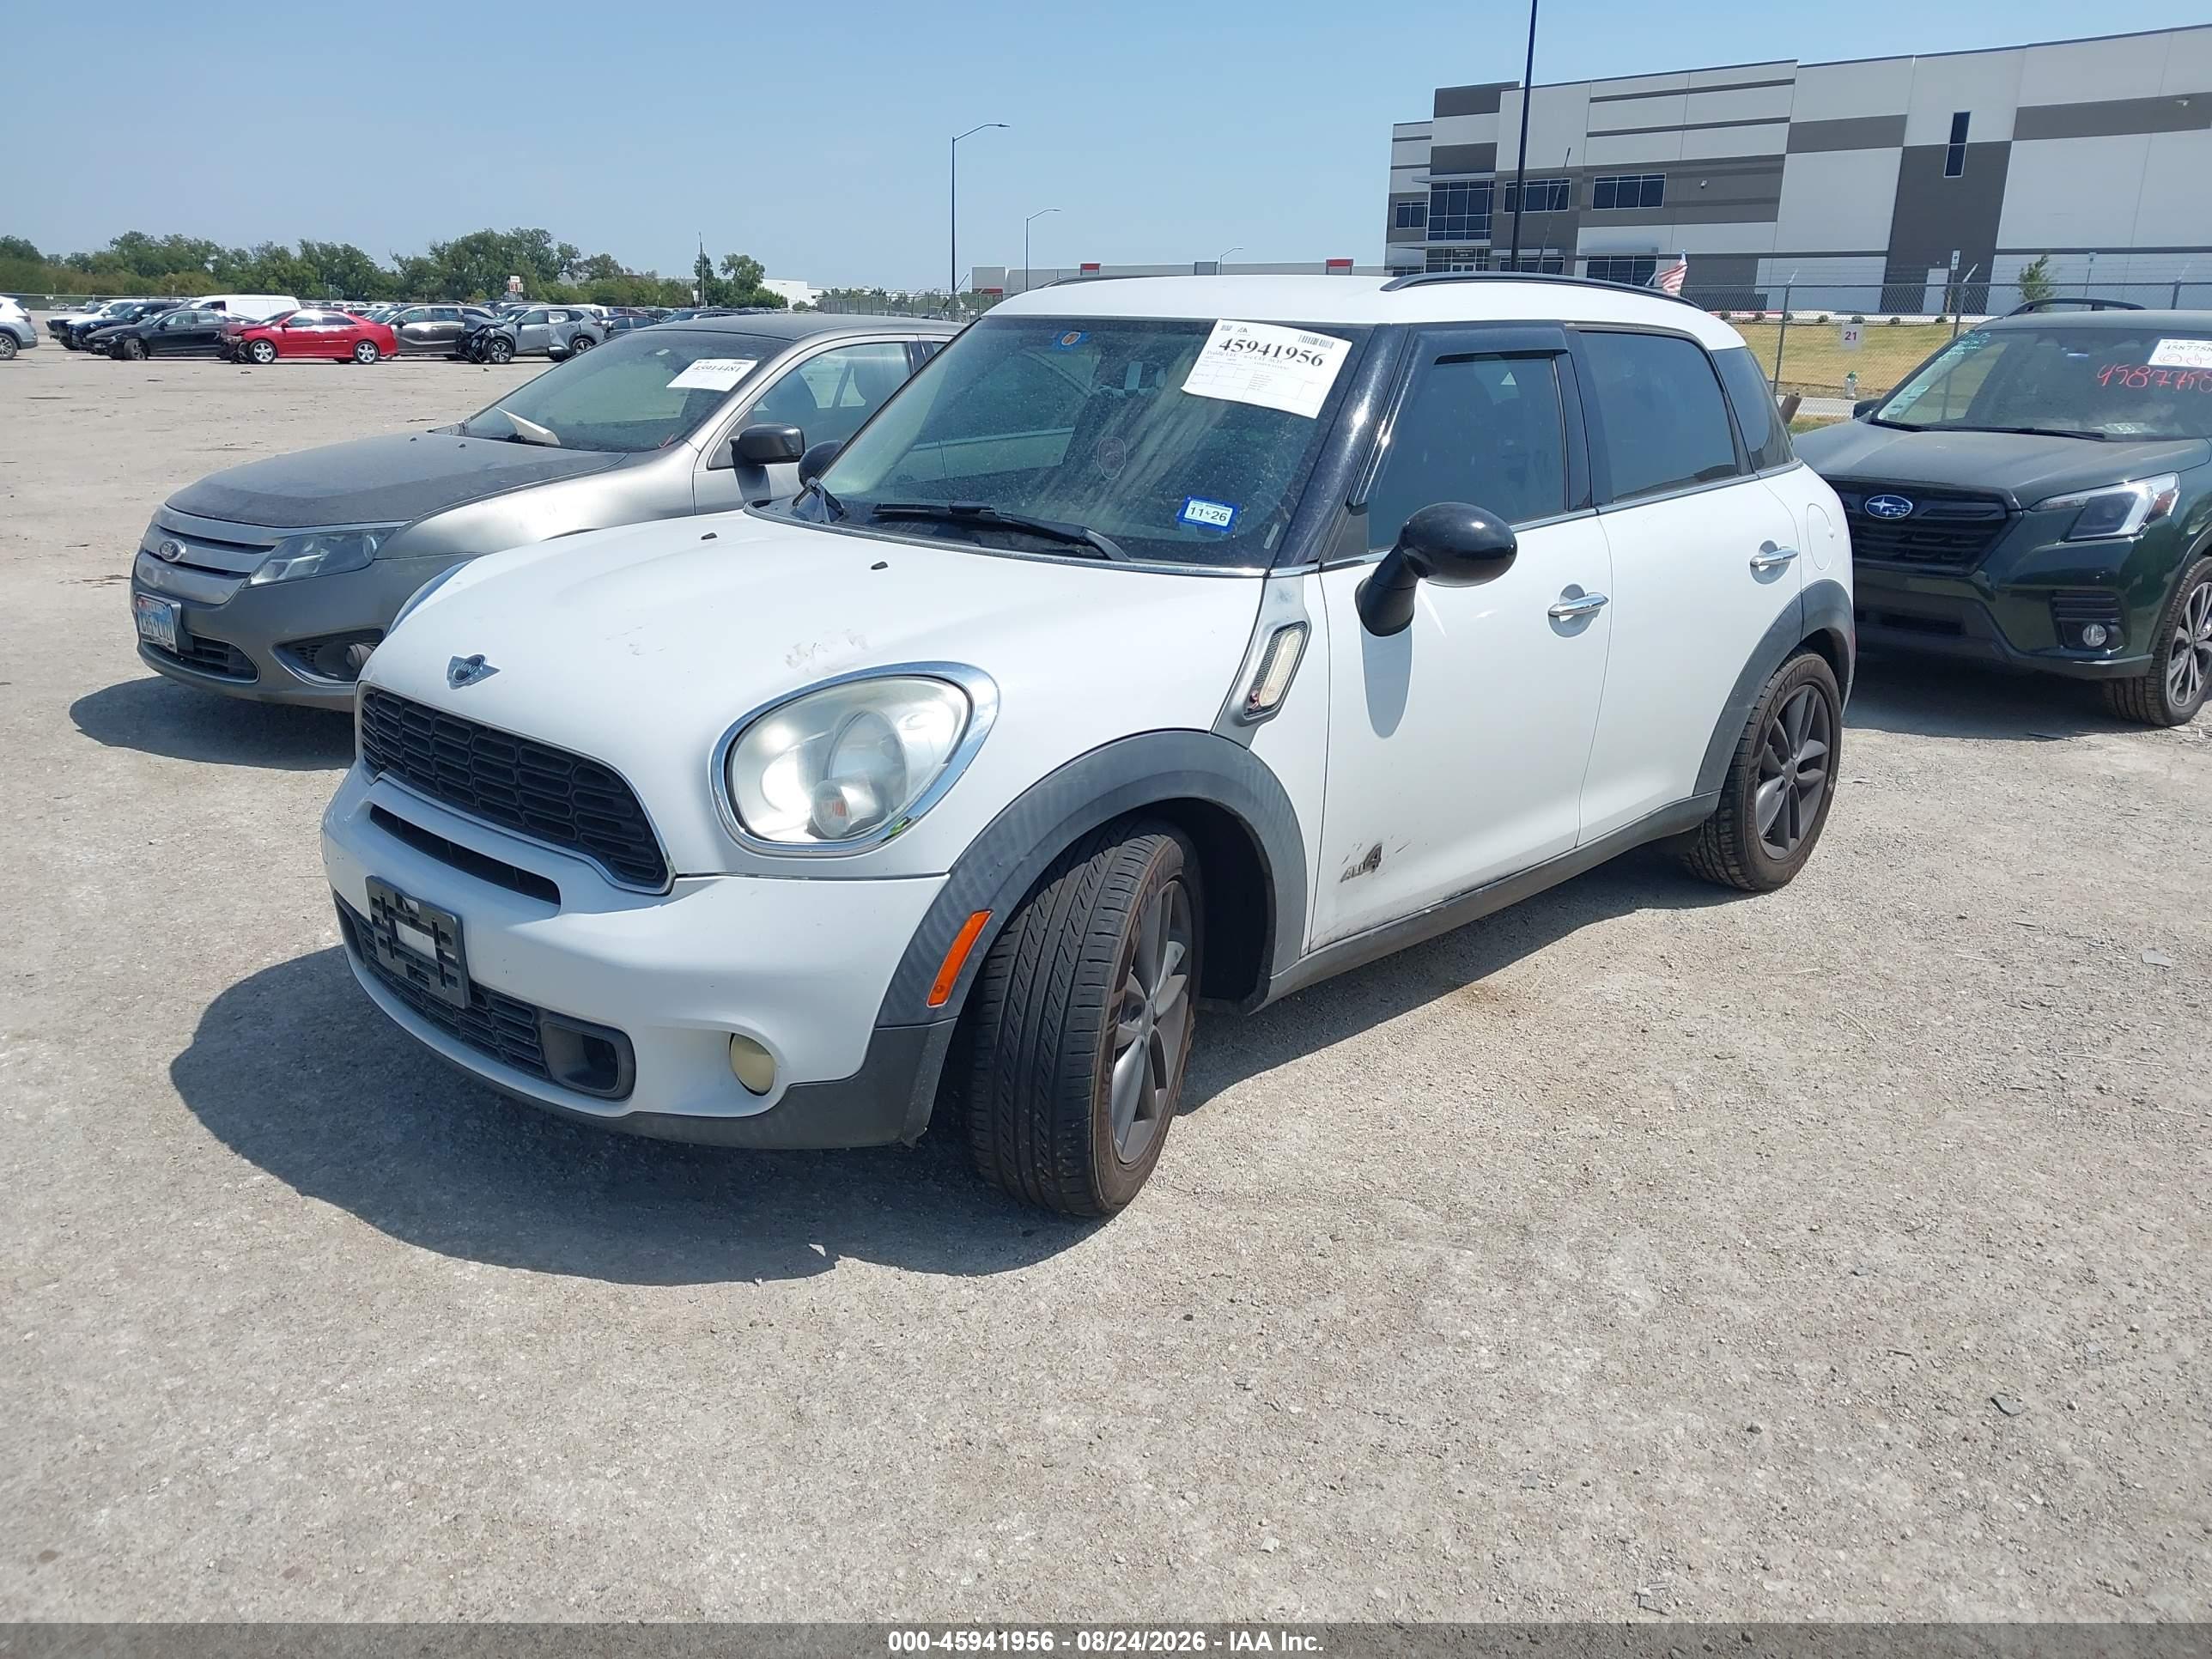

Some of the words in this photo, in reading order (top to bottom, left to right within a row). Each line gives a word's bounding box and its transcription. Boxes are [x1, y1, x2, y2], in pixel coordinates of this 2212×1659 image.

[1844, 331, 1857, 341] 21
[1218, 337, 1327, 367] 45941956
[1191, 507, 1204, 517] 11
[1211, 510, 1228, 522] 26
